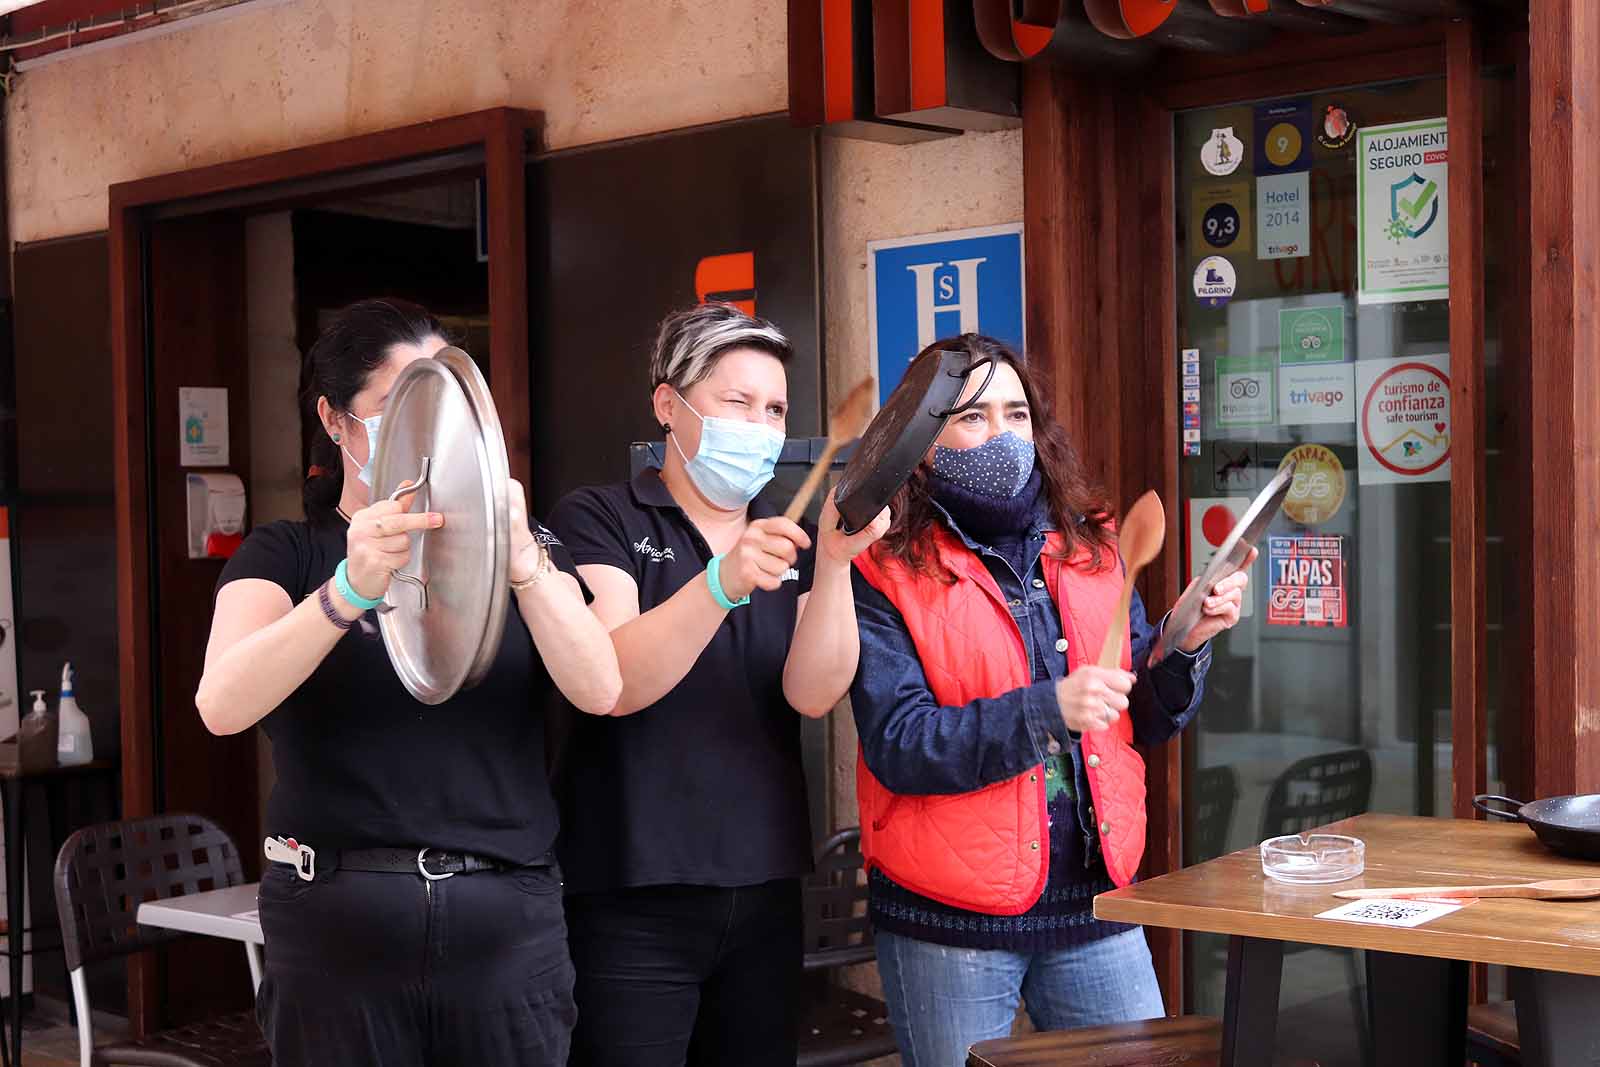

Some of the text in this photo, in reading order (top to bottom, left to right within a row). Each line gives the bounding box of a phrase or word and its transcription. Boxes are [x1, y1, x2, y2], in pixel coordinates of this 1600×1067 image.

[1277, 137, 1289, 153] 9
[1369, 153, 1422, 170] SEGURO
[1266, 185, 1299, 204] Hotel
[1207, 216, 1235, 237] 9,3
[1266, 211, 1300, 227] 2014
[939, 274, 955, 300] S
[1198, 286, 1232, 295] PILGRINO
[907, 257, 987, 358] H
[1384, 380, 1441, 396] turismo de
[1289, 388, 1344, 407] trivago
[1378, 394, 1446, 412] confianza
[1387, 410, 1439, 423] safe tourism
[1291, 447, 1328, 465] TAPAS
[1278, 559, 1333, 585] TAPAS
